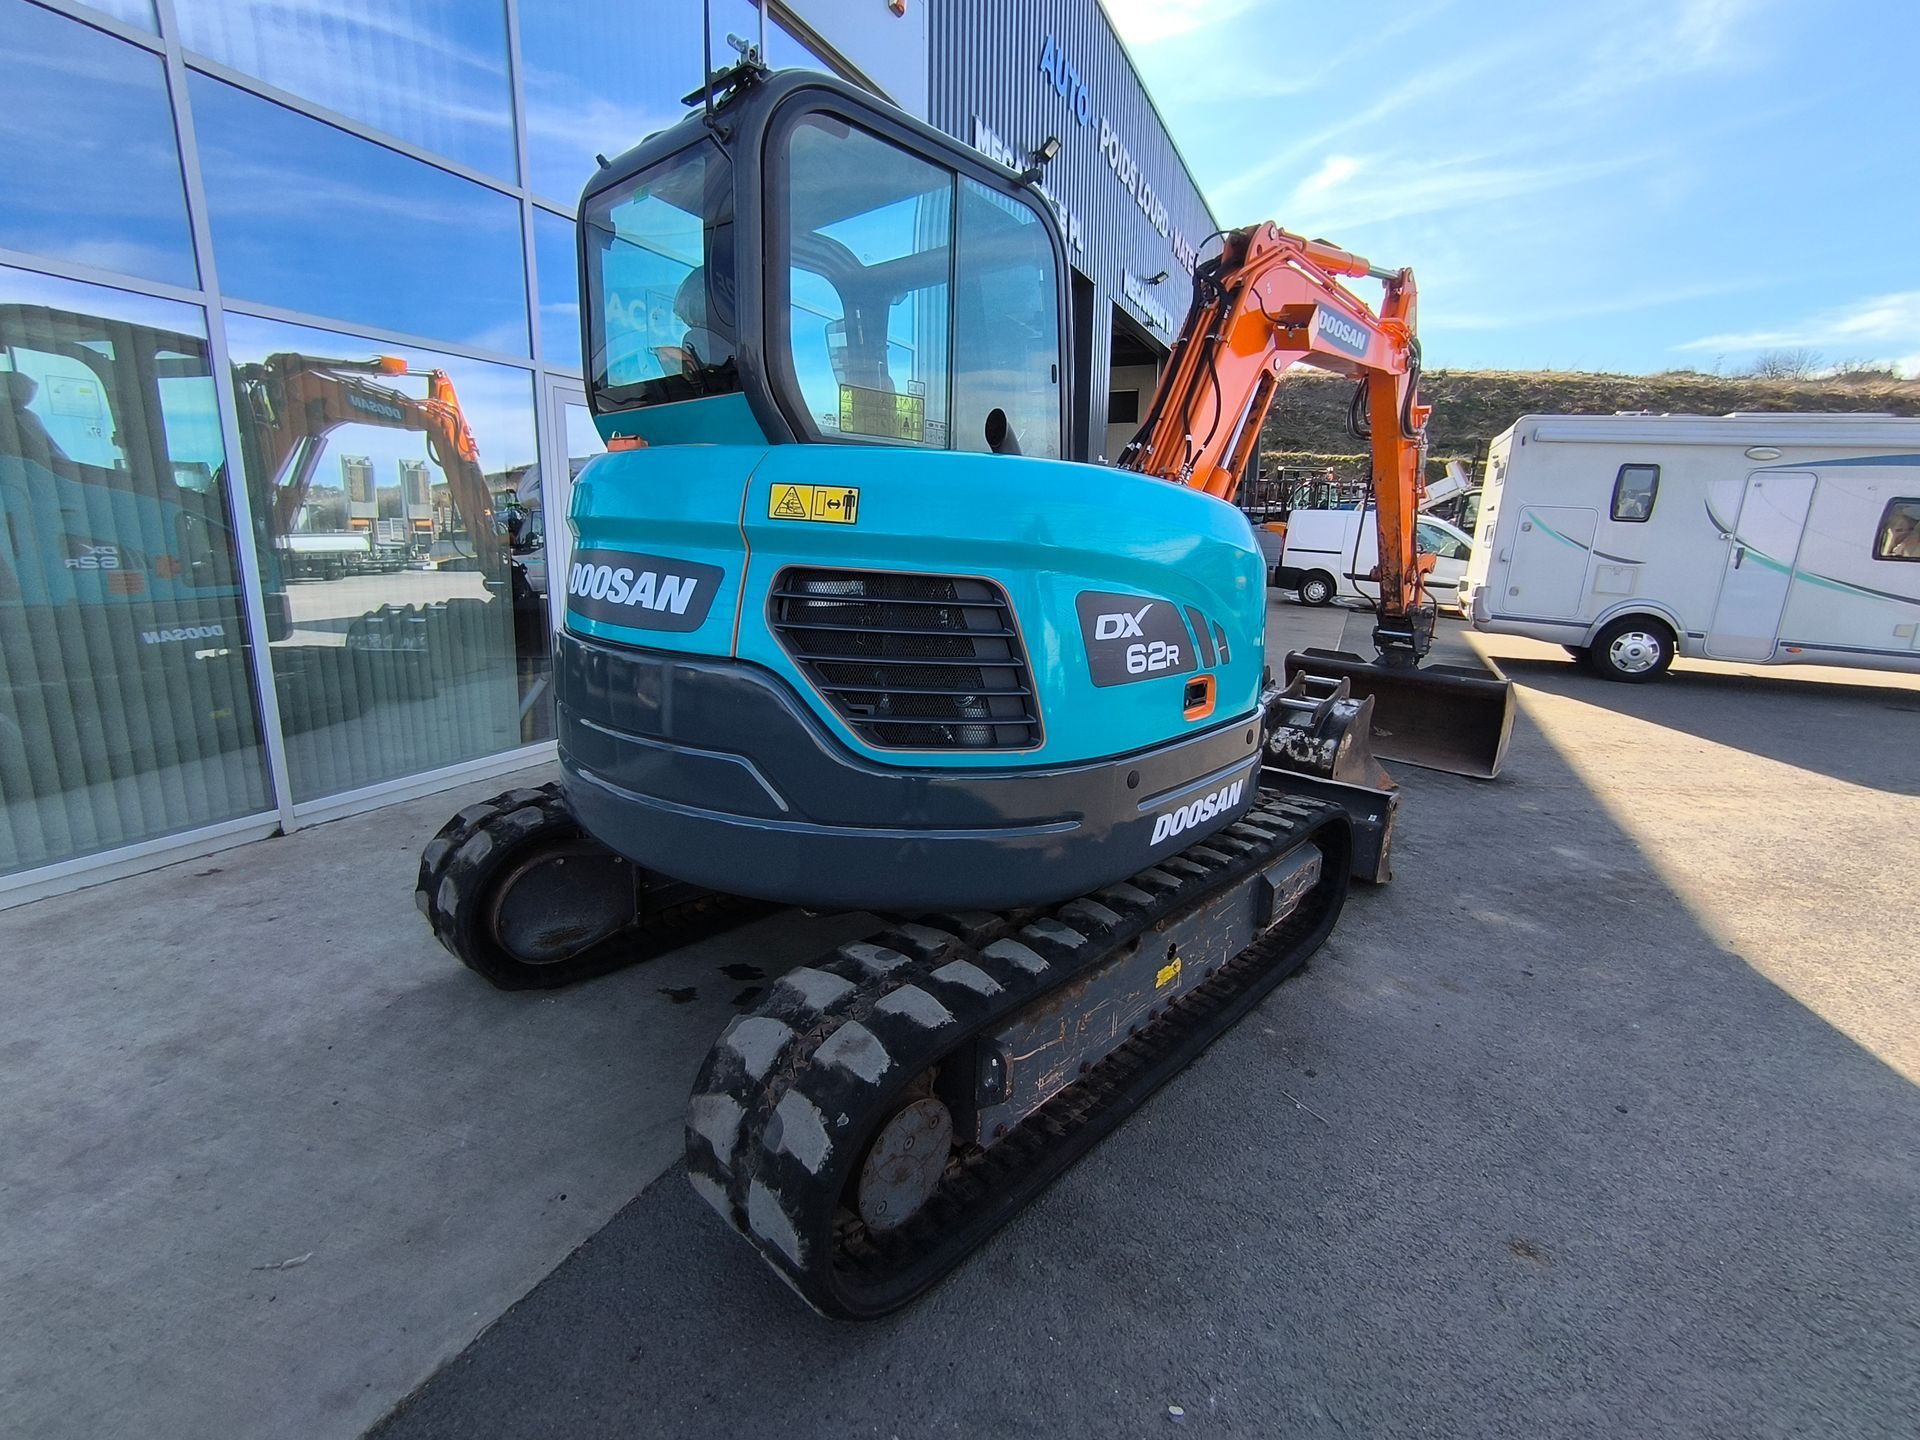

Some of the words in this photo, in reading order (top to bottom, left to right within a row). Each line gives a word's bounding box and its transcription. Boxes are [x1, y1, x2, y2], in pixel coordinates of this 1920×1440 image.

[1040, 34, 1089, 127] AUTO
[1099, 116, 1137, 196] POIDS
[1136, 172, 1170, 239] LOURD
[1319, 310, 1366, 350] DOOSAN
[569, 562, 698, 615] DOOSAN
[1095, 603, 1153, 641] DX
[1126, 640, 1180, 675] 62R
[1149, 779, 1244, 846] DOOSAN
